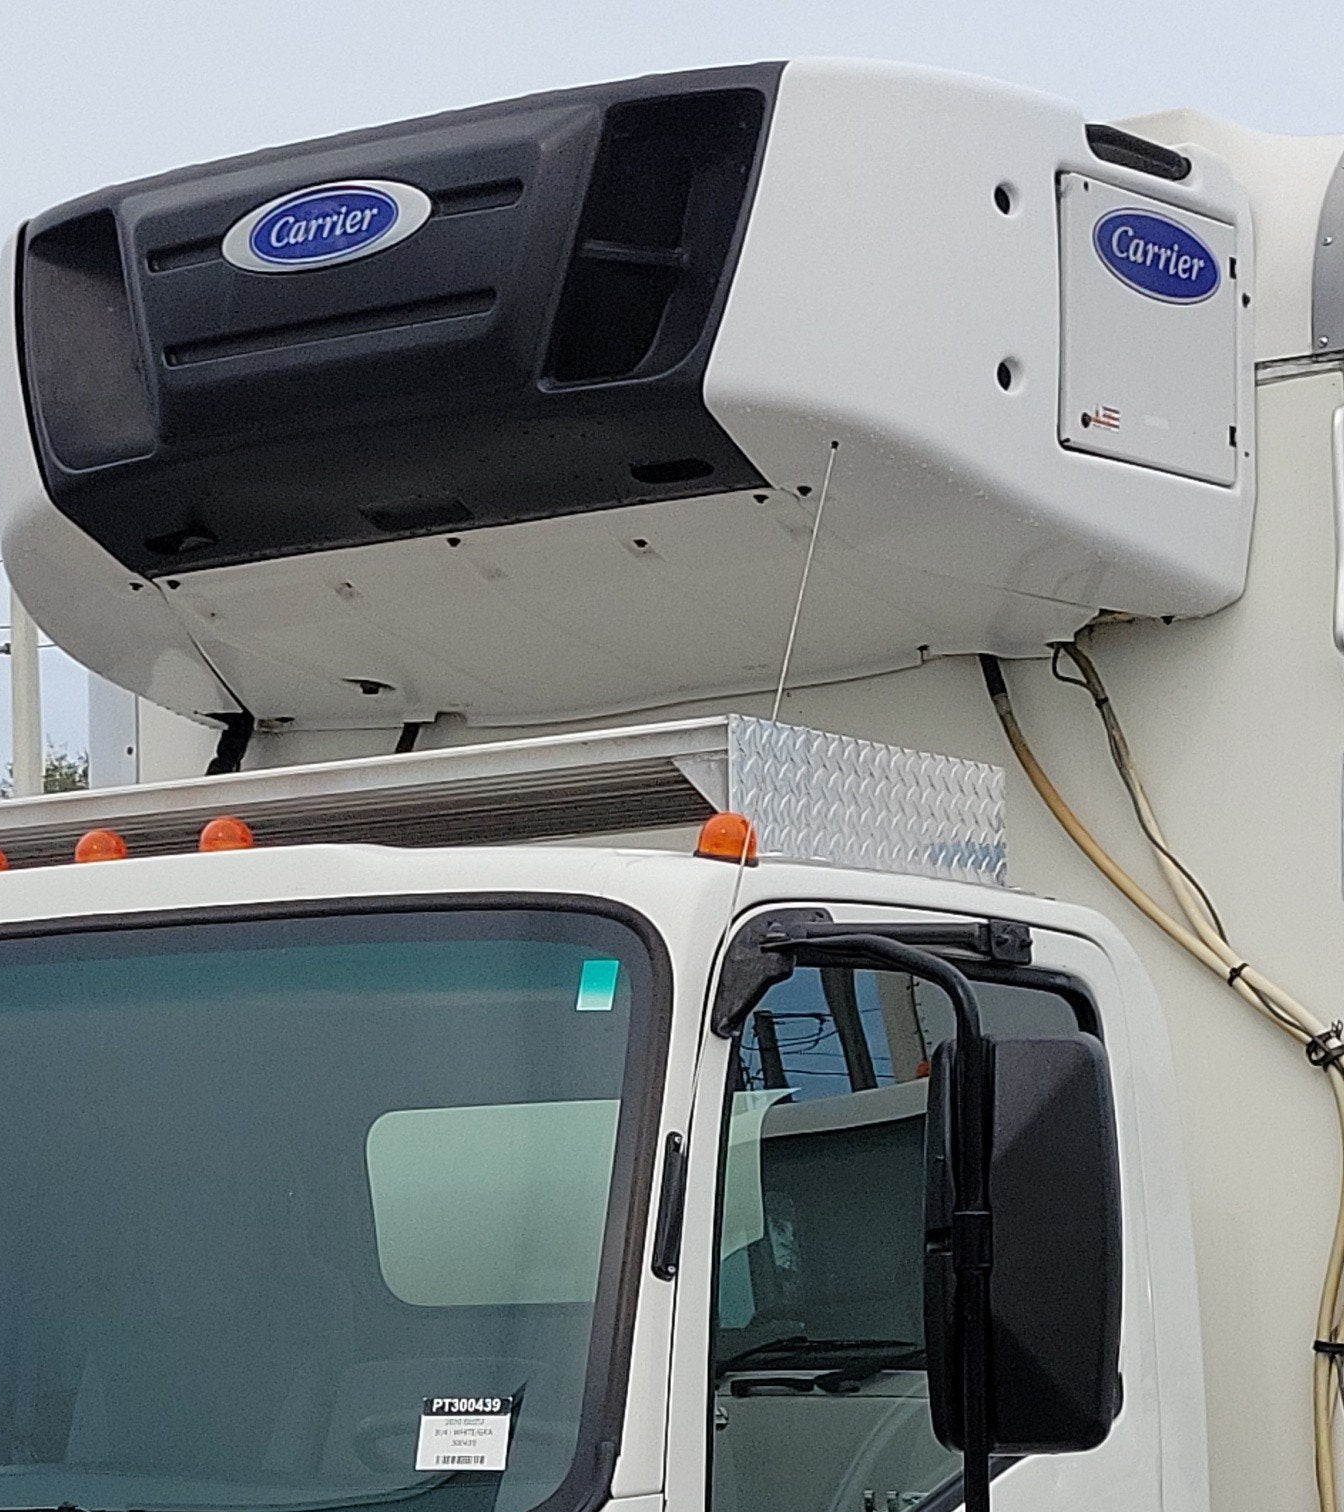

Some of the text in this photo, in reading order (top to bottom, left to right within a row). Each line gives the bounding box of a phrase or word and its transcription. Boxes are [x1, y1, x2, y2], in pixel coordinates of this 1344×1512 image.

[270, 206, 378, 248] Carrier
[1111, 226, 1205, 281] Carrier
[432, 1398, 501, 1412] PT300439
